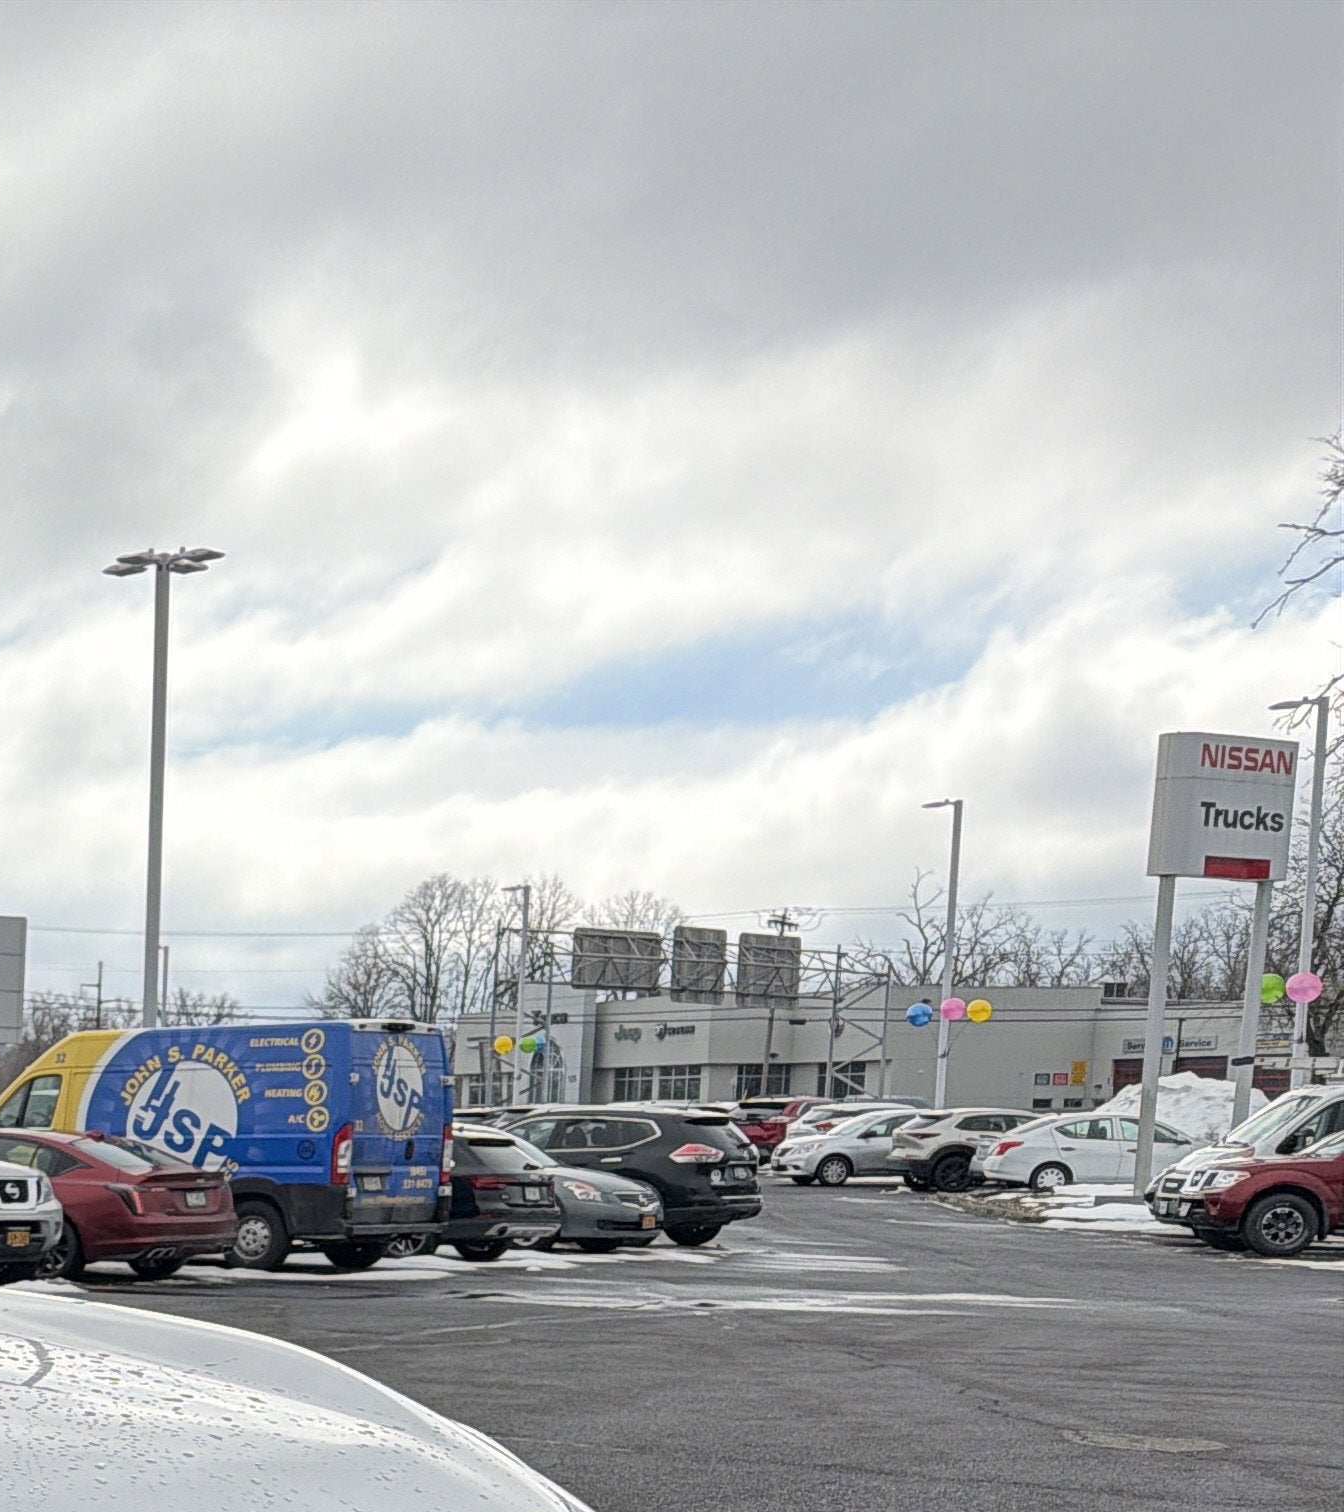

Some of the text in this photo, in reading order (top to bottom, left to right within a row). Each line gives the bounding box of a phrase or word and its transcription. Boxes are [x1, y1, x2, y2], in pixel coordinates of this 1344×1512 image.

[1200, 743, 1294, 775] NISSAN
[1200, 801, 1285, 832] Trucks
[250, 1037, 299, 1048] ELECTRICAL
[1127, 1041, 1147, 1051] Serv
[1179, 1038, 1213, 1048] Service
[255, 1062, 302, 1073] PLUMBING
[120, 1044, 251, 1106] JOHN S. PARKER
[264, 1088, 303, 1098] HEATING
[288, 1115, 305, 1124] A/C
